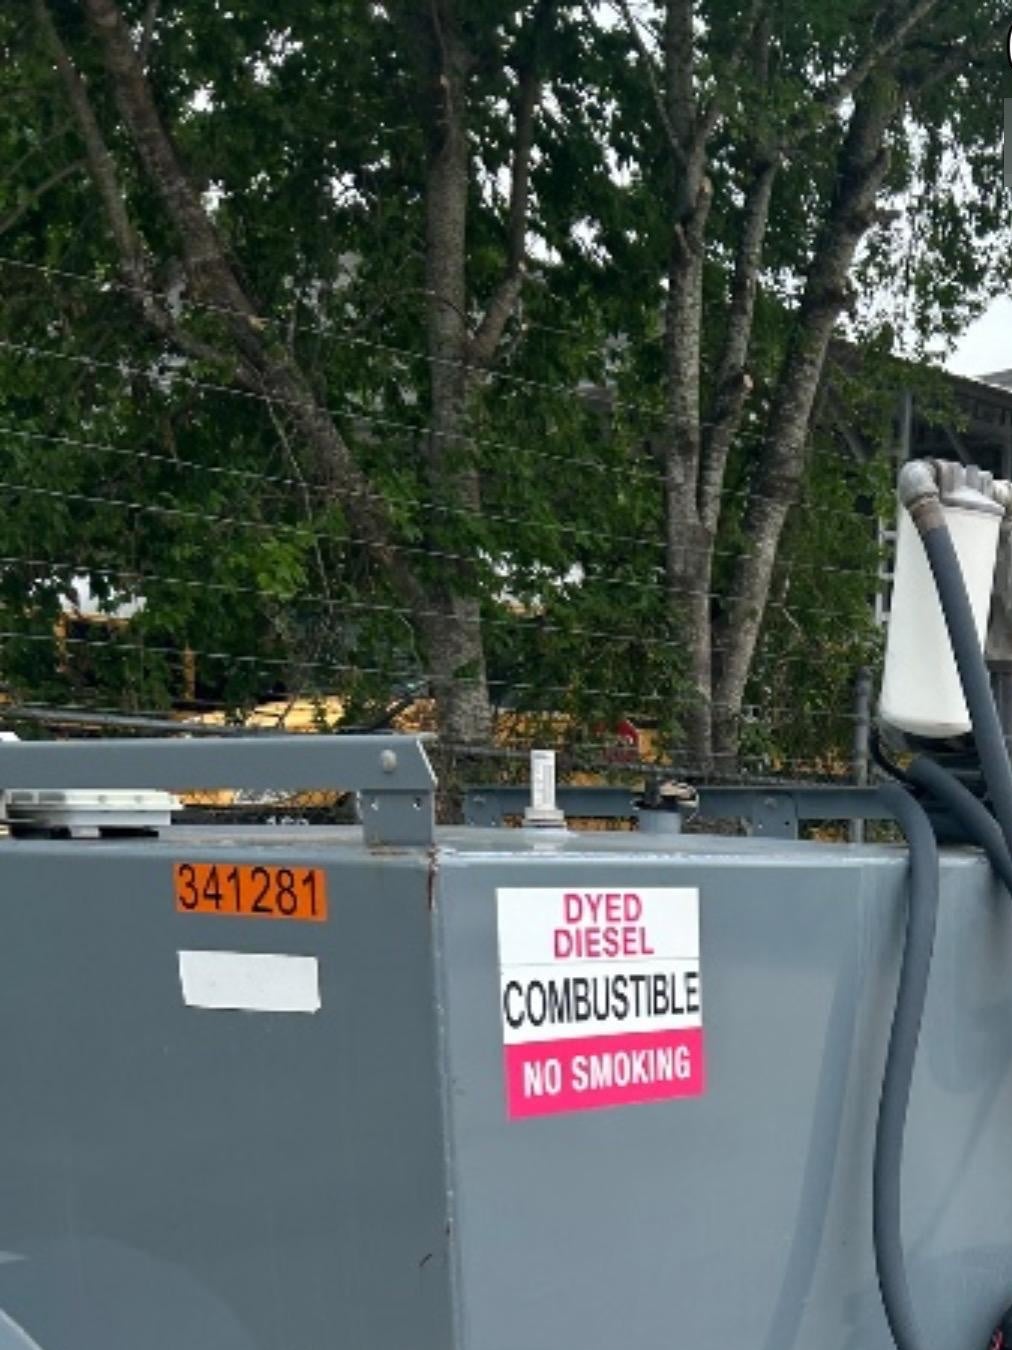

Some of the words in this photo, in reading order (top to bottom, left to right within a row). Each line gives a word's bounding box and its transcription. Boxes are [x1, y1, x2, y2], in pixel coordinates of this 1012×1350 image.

[177, 863, 319, 917] 341281
[562, 893, 643, 924] DYED
[553, 927, 655, 959] DIESEL
[503, 971, 700, 1030] COMBUSTIBLE
[522, 1060, 563, 1098] NO
[570, 1045, 691, 1093] SMOKING
